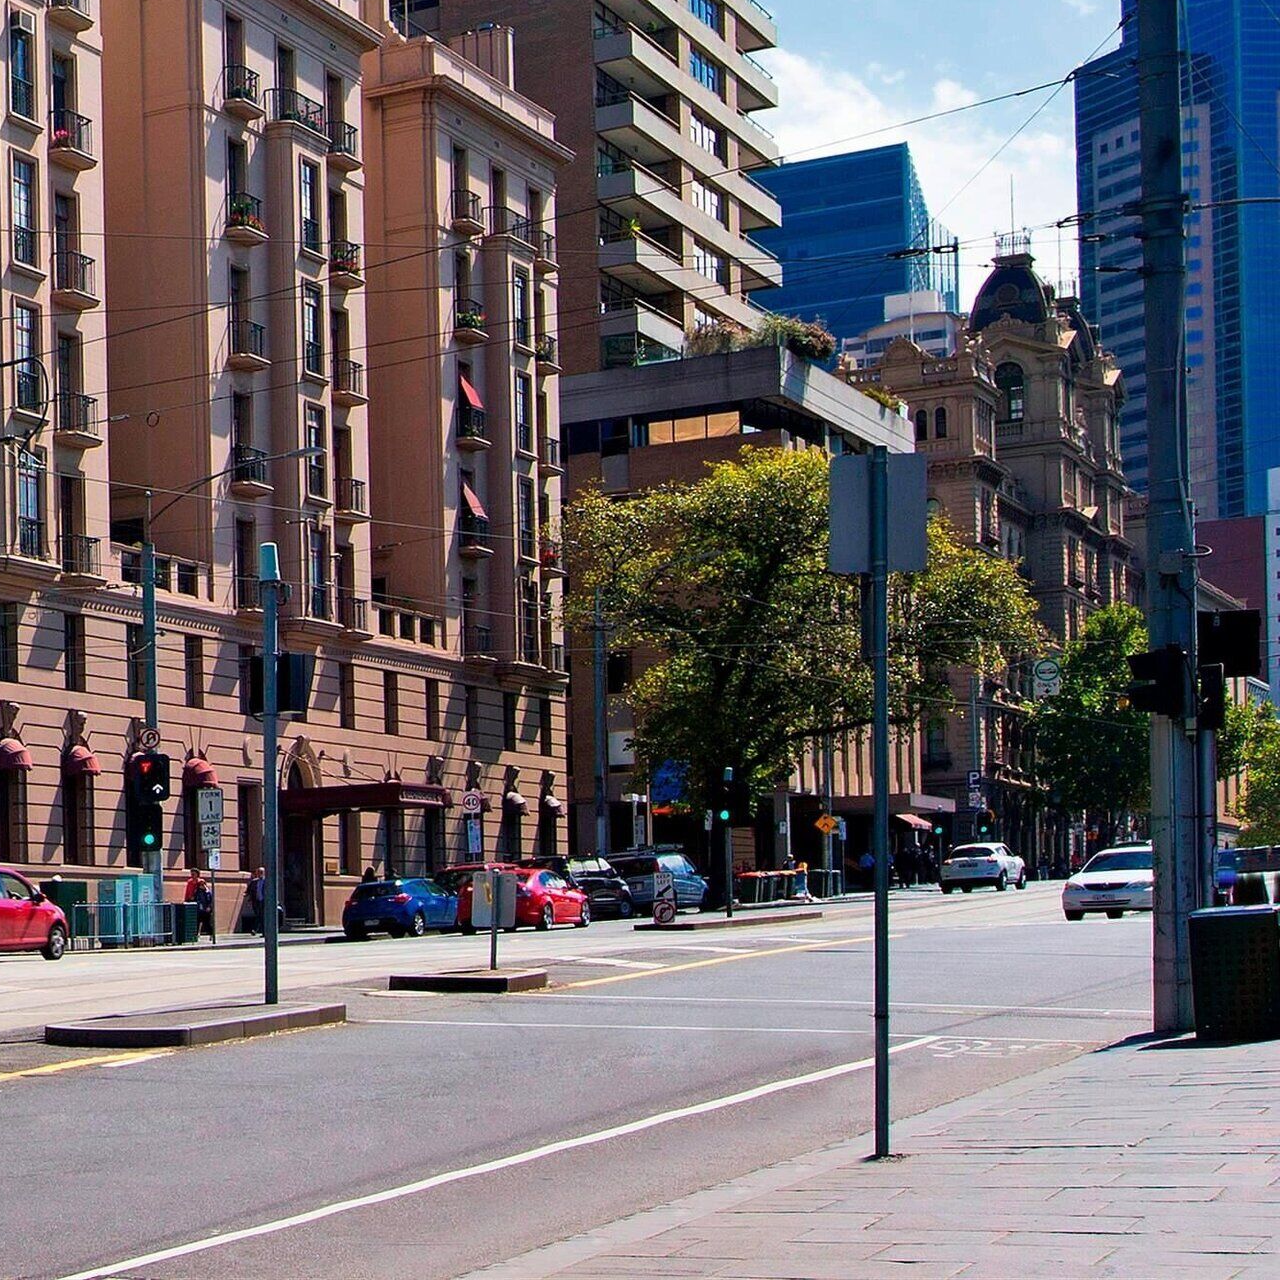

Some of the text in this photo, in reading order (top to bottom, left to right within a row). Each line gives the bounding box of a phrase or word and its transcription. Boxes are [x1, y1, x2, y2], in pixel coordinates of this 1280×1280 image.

[969, 772, 980, 784] P
[200, 791, 220, 799] FORM
[208, 800, 213, 812] 1
[465, 797, 478, 807] 40
[200, 813, 220, 821] LANE
